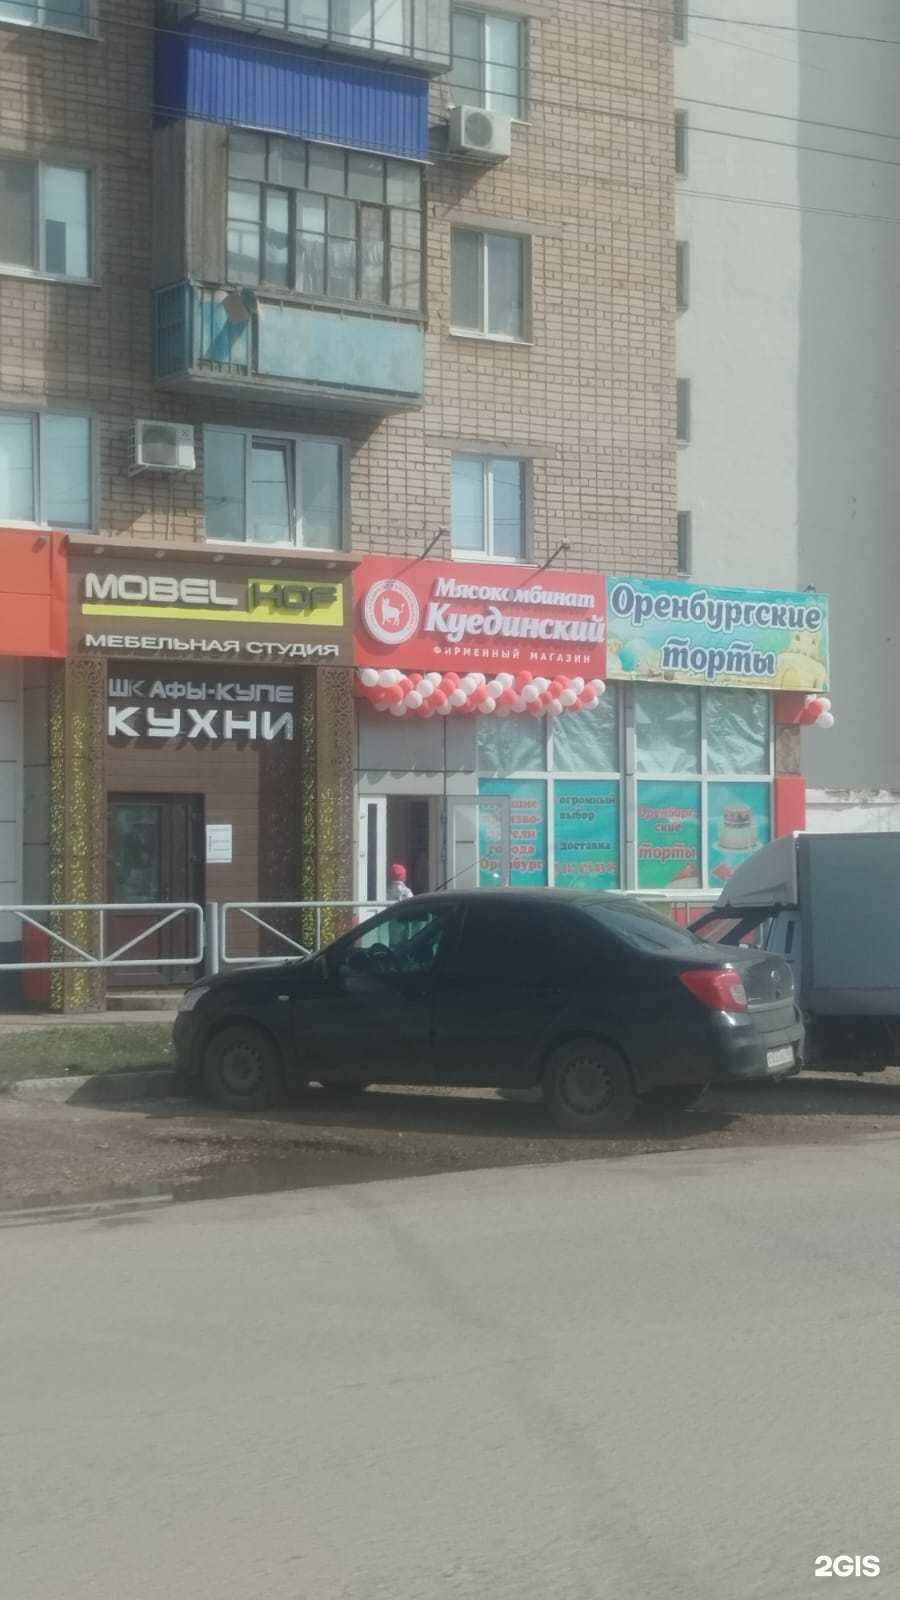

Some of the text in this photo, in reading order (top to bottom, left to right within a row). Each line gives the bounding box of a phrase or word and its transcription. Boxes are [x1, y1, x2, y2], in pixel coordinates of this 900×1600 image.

[85, 573, 239, 606] MOBEL
[247, 582, 339, 616] HOF
[435, 577, 595, 608] Мясокомбинат
[610, 581, 822, 633] Оренбургские
[425, 602, 605, 643] Куединский
[85, 634, 340, 657] МЕБЕЛЬНАЯ СТУДИЯ
[433, 646, 591, 664] ФИРМЕННЫЙ МАГАЗИН
[661, 636, 776, 681] торты
[108, 706, 294, 740] КУХНИ
